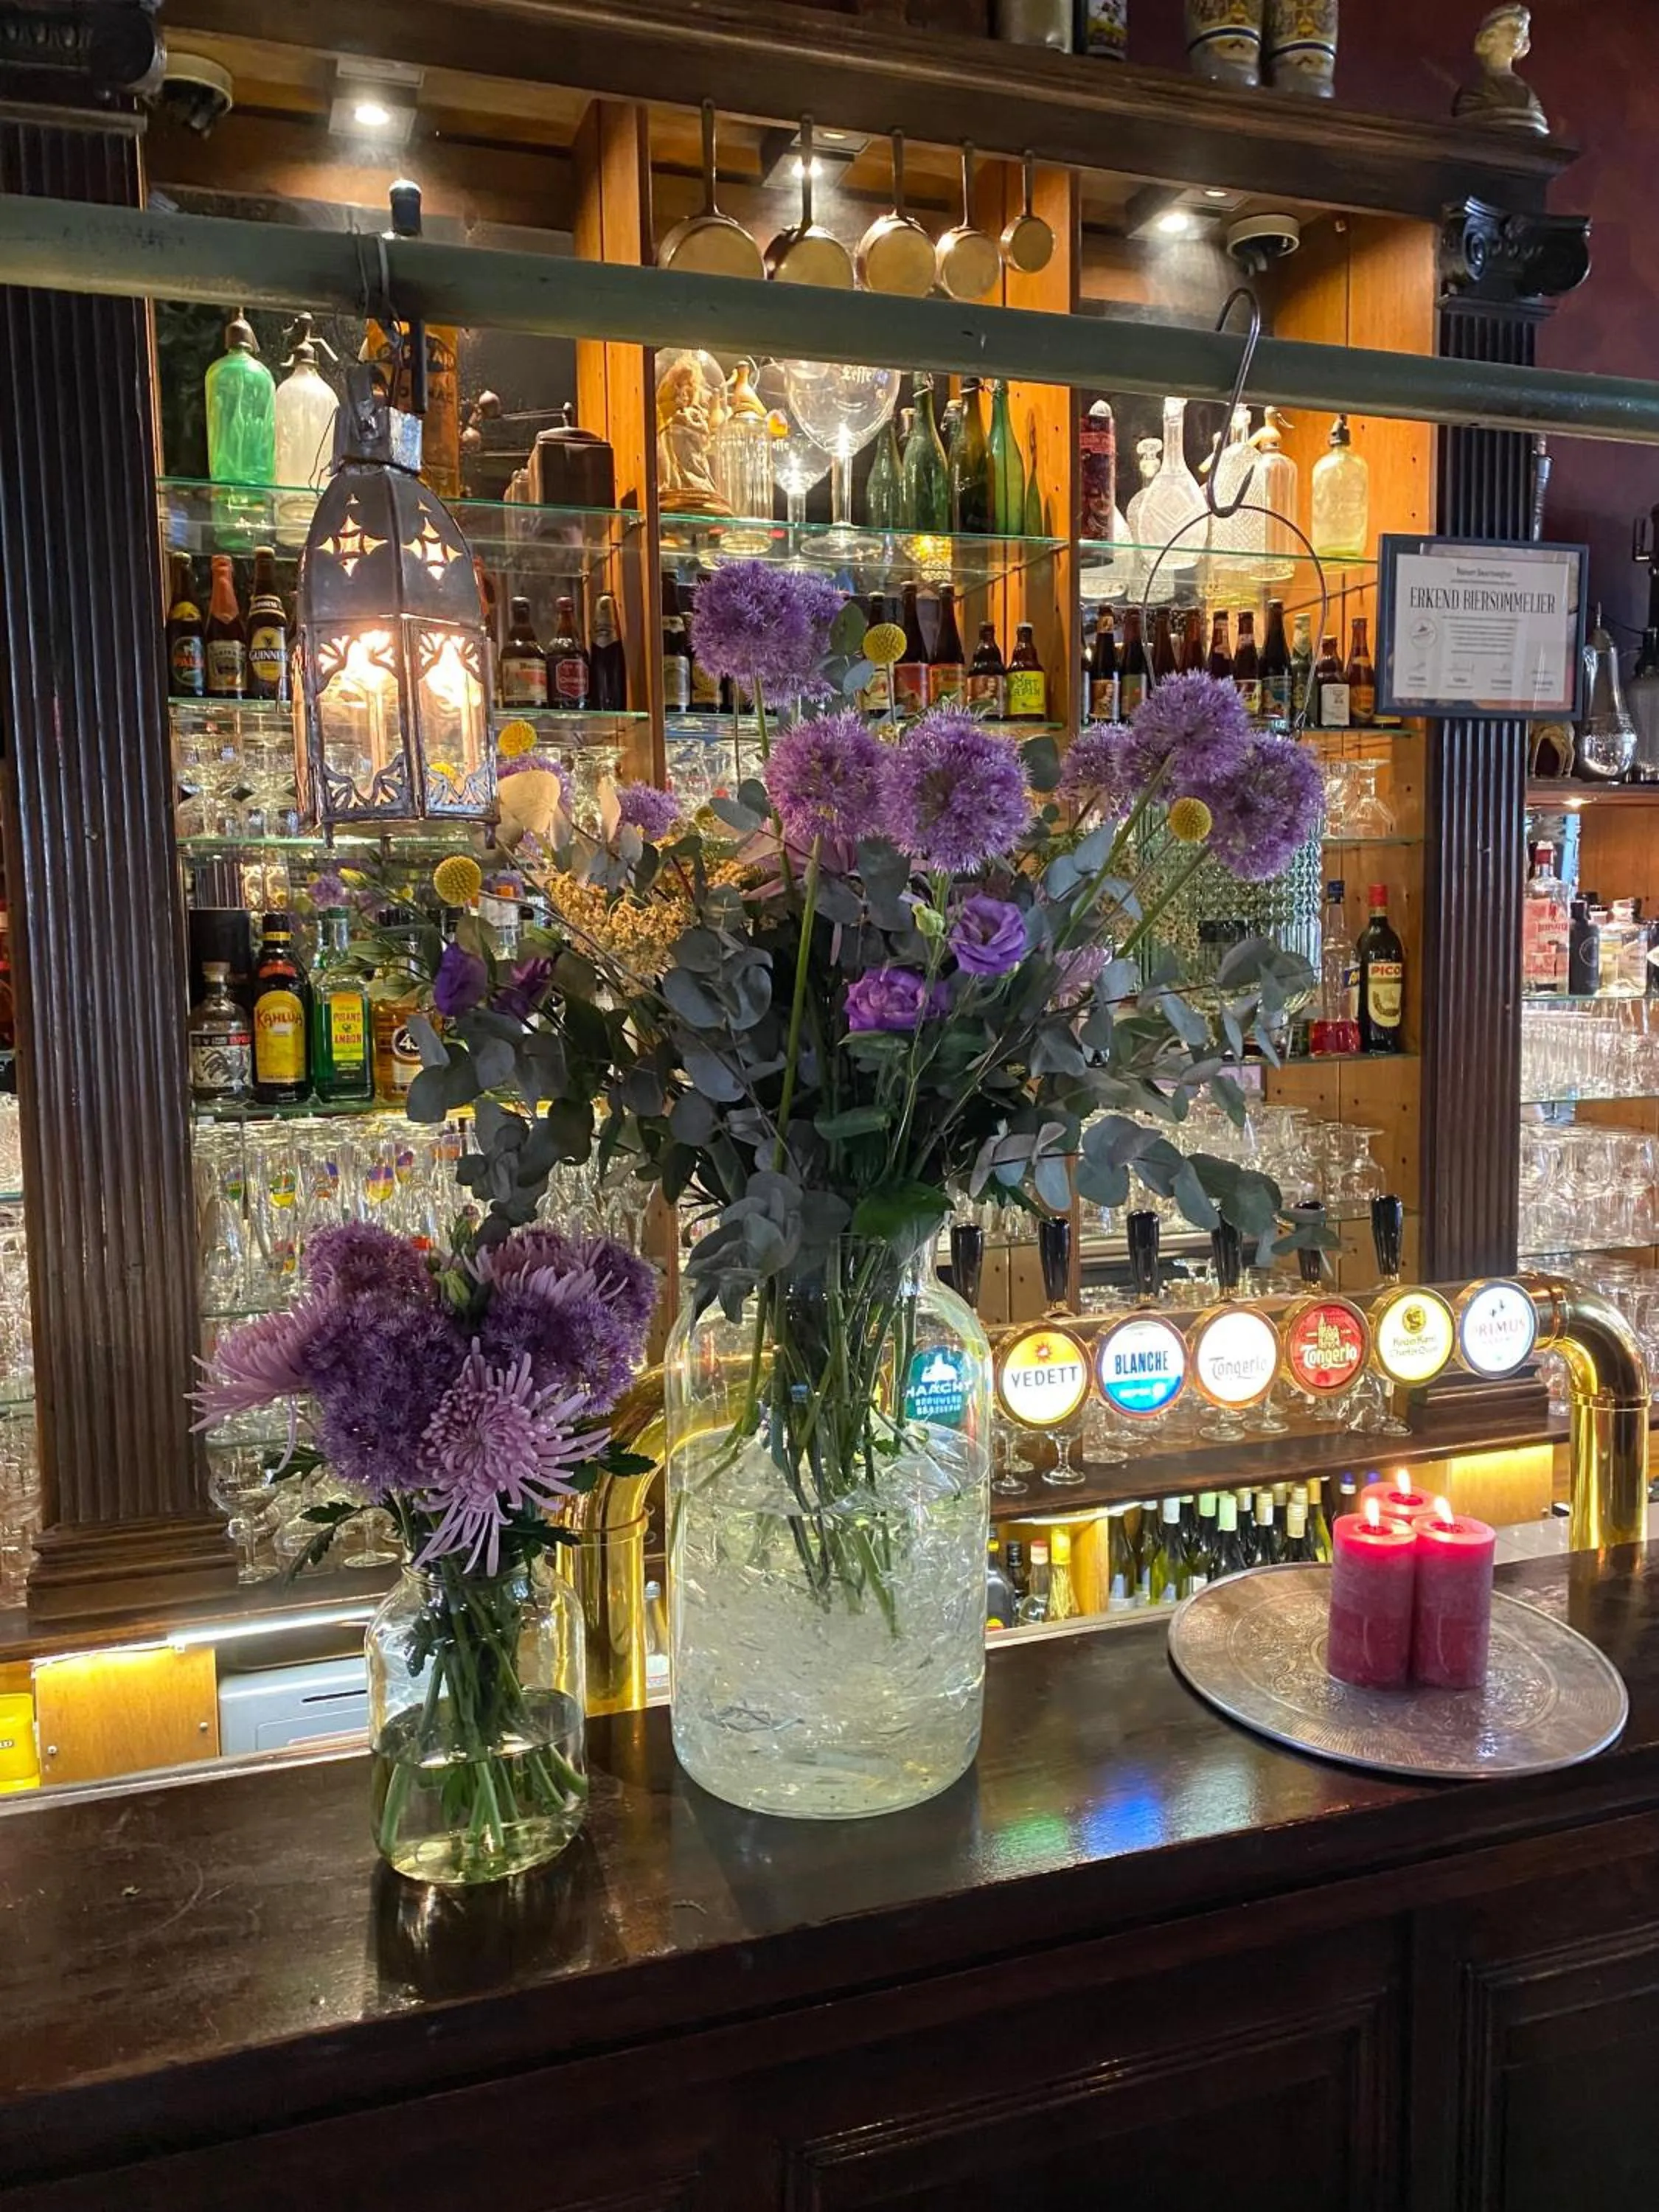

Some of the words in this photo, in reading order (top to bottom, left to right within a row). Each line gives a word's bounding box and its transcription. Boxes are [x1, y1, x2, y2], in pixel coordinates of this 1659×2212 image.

[1410, 586, 1458, 610] ERKEND
[1464, 589, 1556, 614] BIERSOMMELIER
[1115, 1350, 1169, 1375] BLANCHE
[1208, 1354, 1267, 1381] Tongerlo
[1300, 1341, 1357, 1369] Tongerlo
[1011, 1366, 1078, 1388] VEDETT
